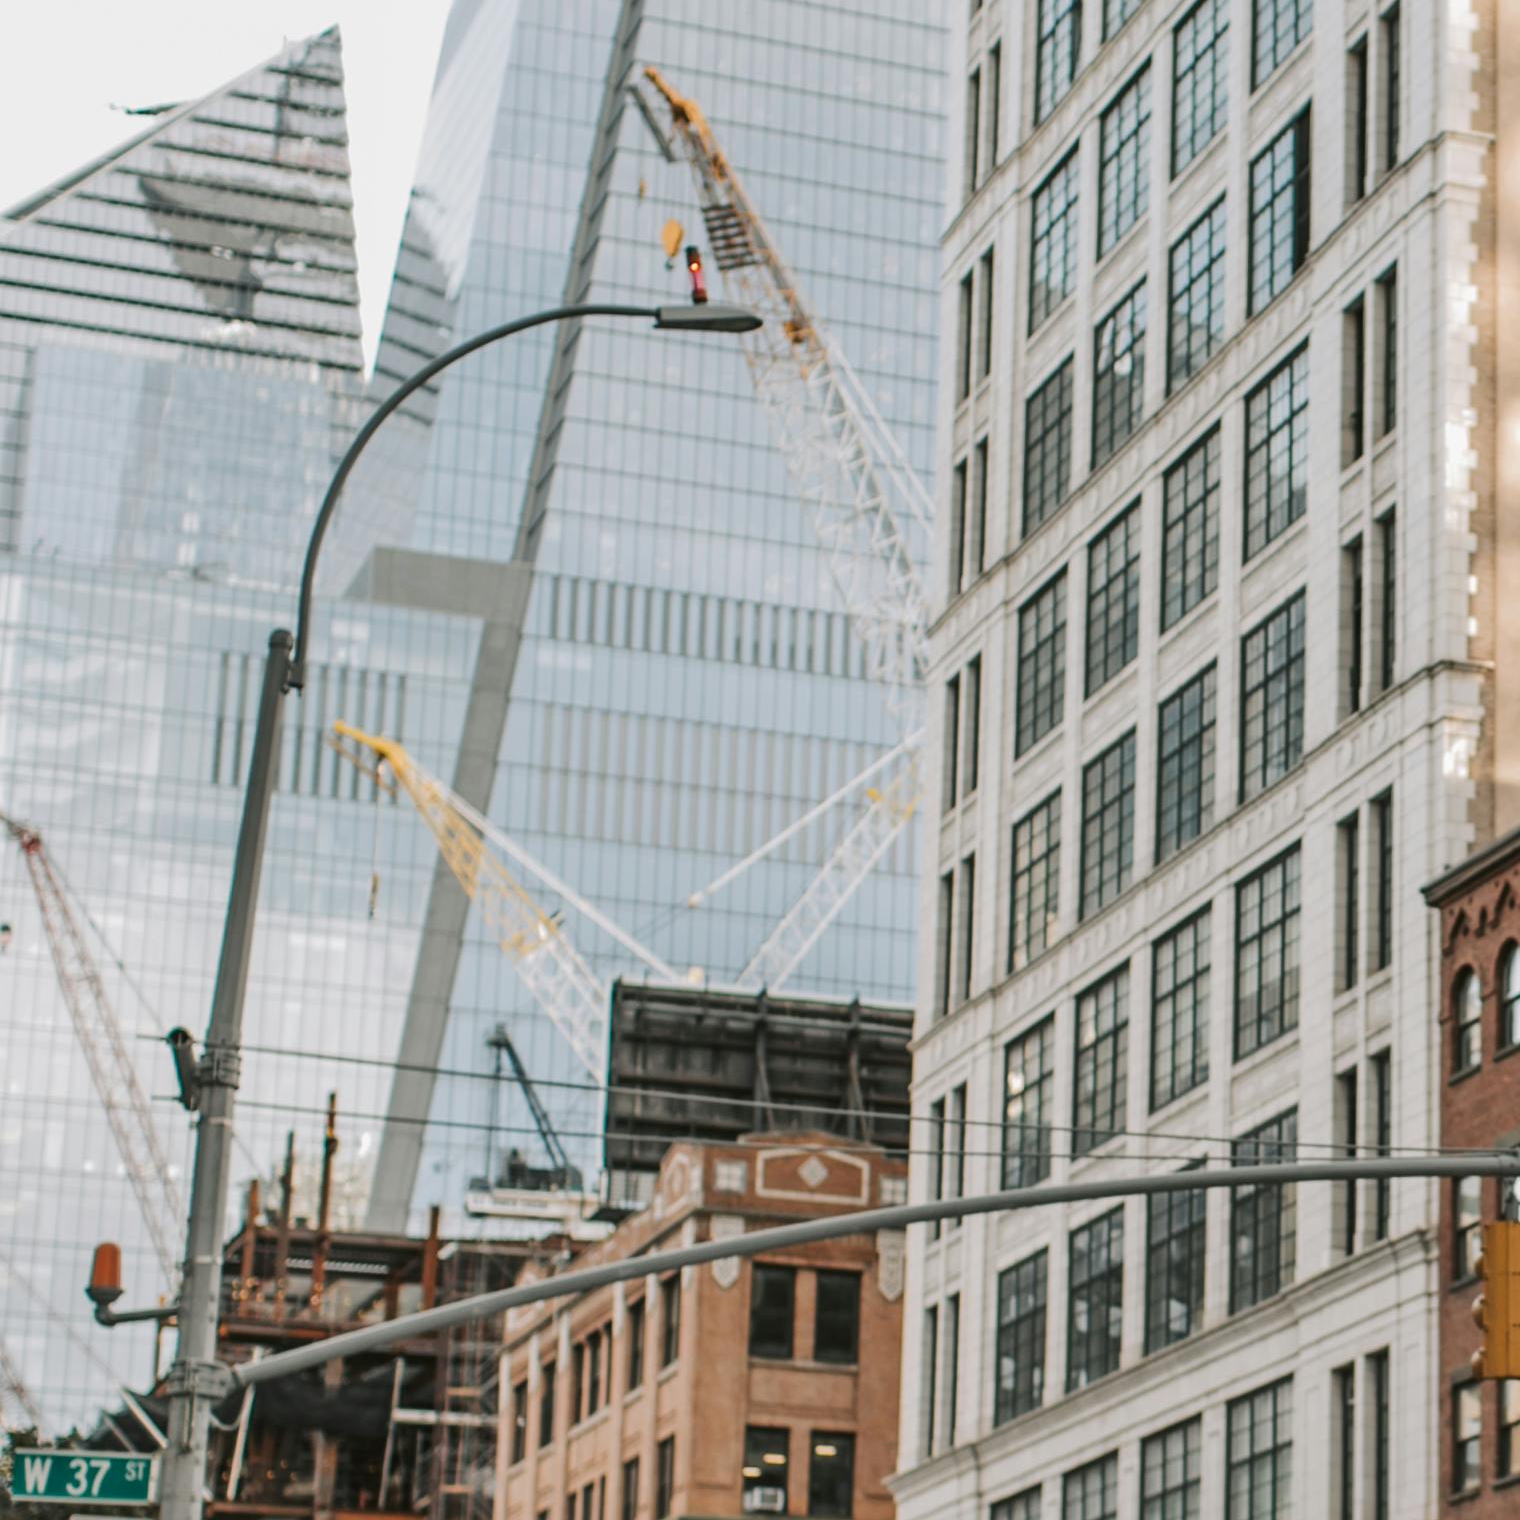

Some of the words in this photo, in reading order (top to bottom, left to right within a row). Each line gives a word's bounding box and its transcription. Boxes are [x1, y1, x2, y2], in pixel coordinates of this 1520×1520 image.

[24, 1457, 52, 1494] W
[65, 1459, 111, 1496] 37
[125, 1462, 147, 1481] ST
